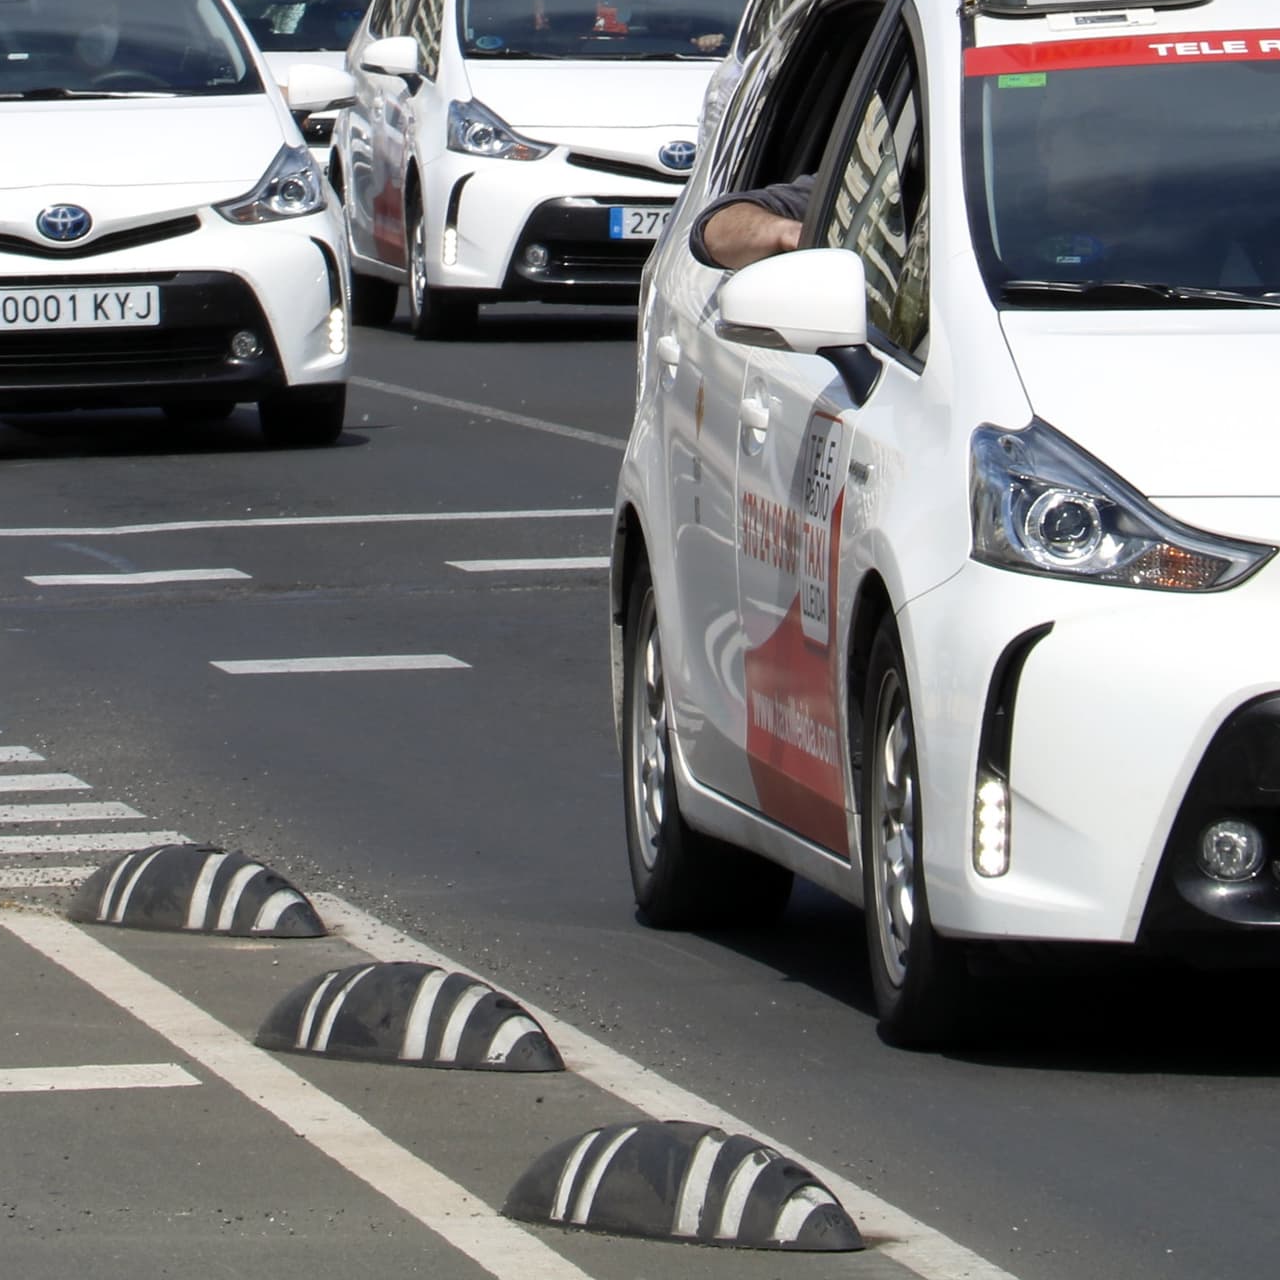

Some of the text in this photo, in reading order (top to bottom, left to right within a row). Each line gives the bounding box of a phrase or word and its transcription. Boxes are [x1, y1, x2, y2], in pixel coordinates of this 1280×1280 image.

[1149, 40, 1248, 57] TELE
[2, 291, 152, 324] 0001 KYJ
[809, 434, 837, 481] TELE
[803, 522, 826, 583] TAXI
